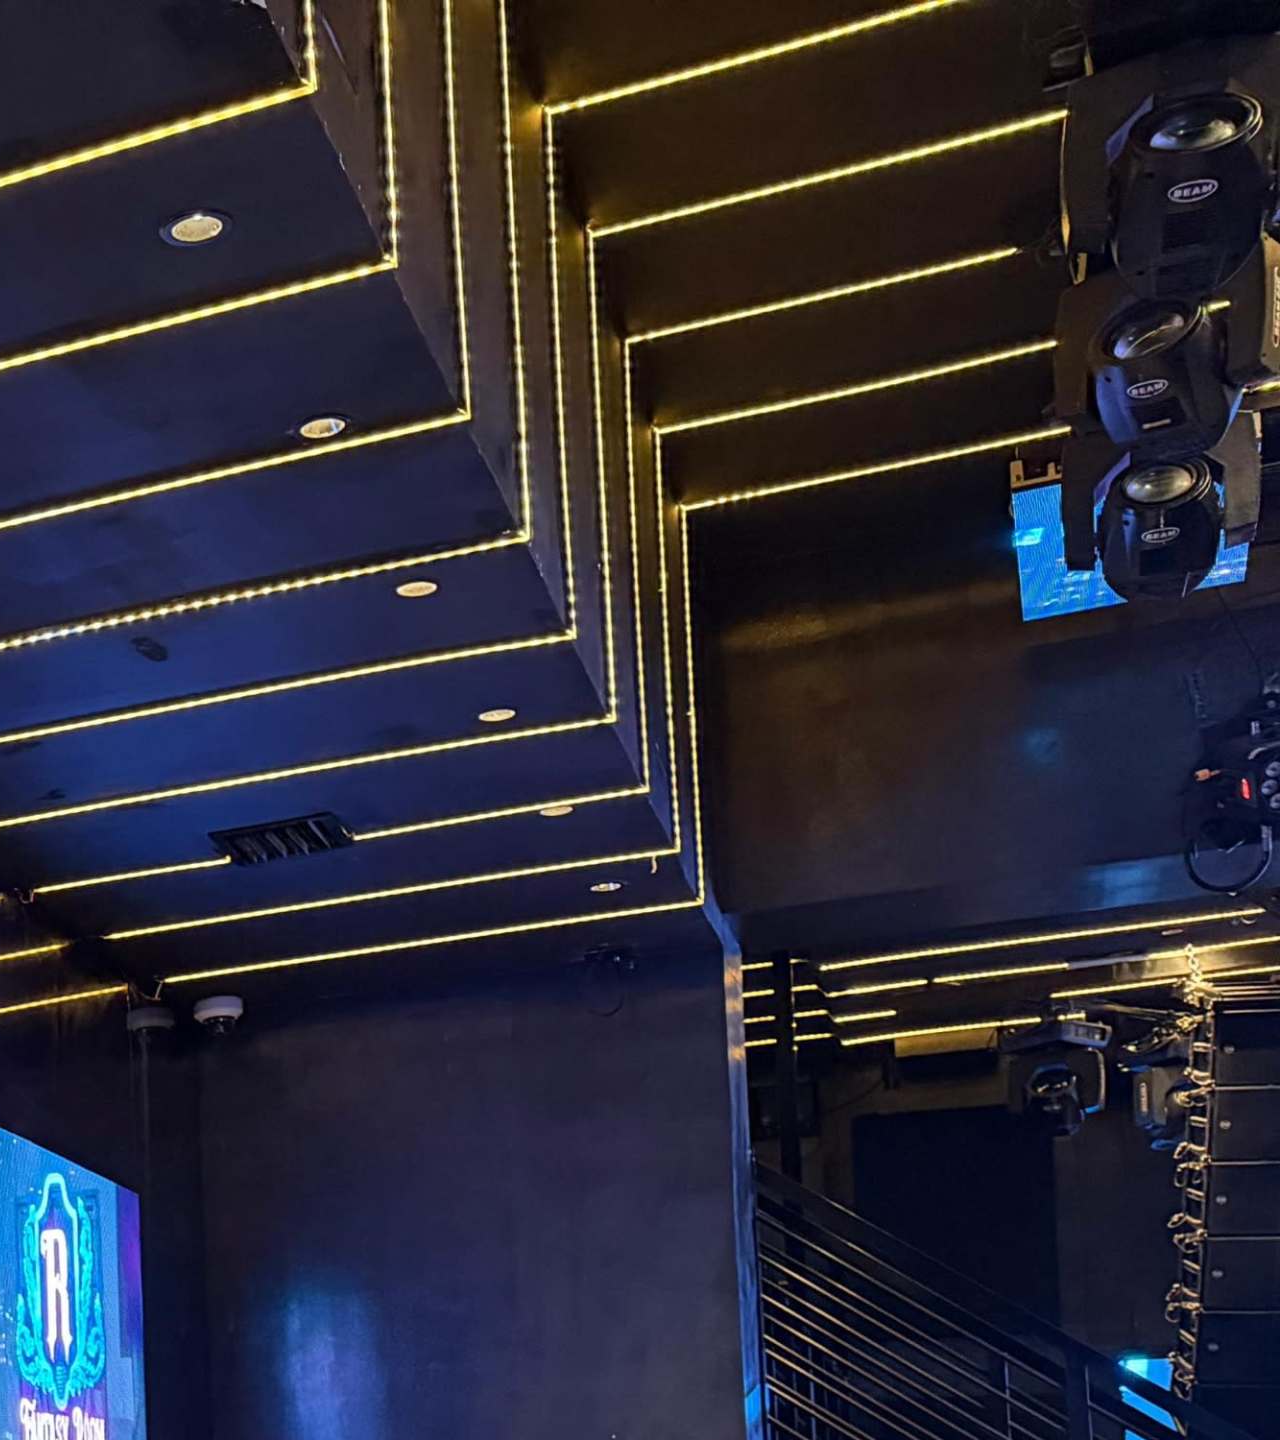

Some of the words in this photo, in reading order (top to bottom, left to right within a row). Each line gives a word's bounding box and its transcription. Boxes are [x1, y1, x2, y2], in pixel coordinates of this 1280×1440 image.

[1173, 184, 1213, 197] BEAM
[1131, 382, 1163, 396] BEAM
[1145, 530, 1177, 541] BEAM
[40, 1228, 73, 1364] R
